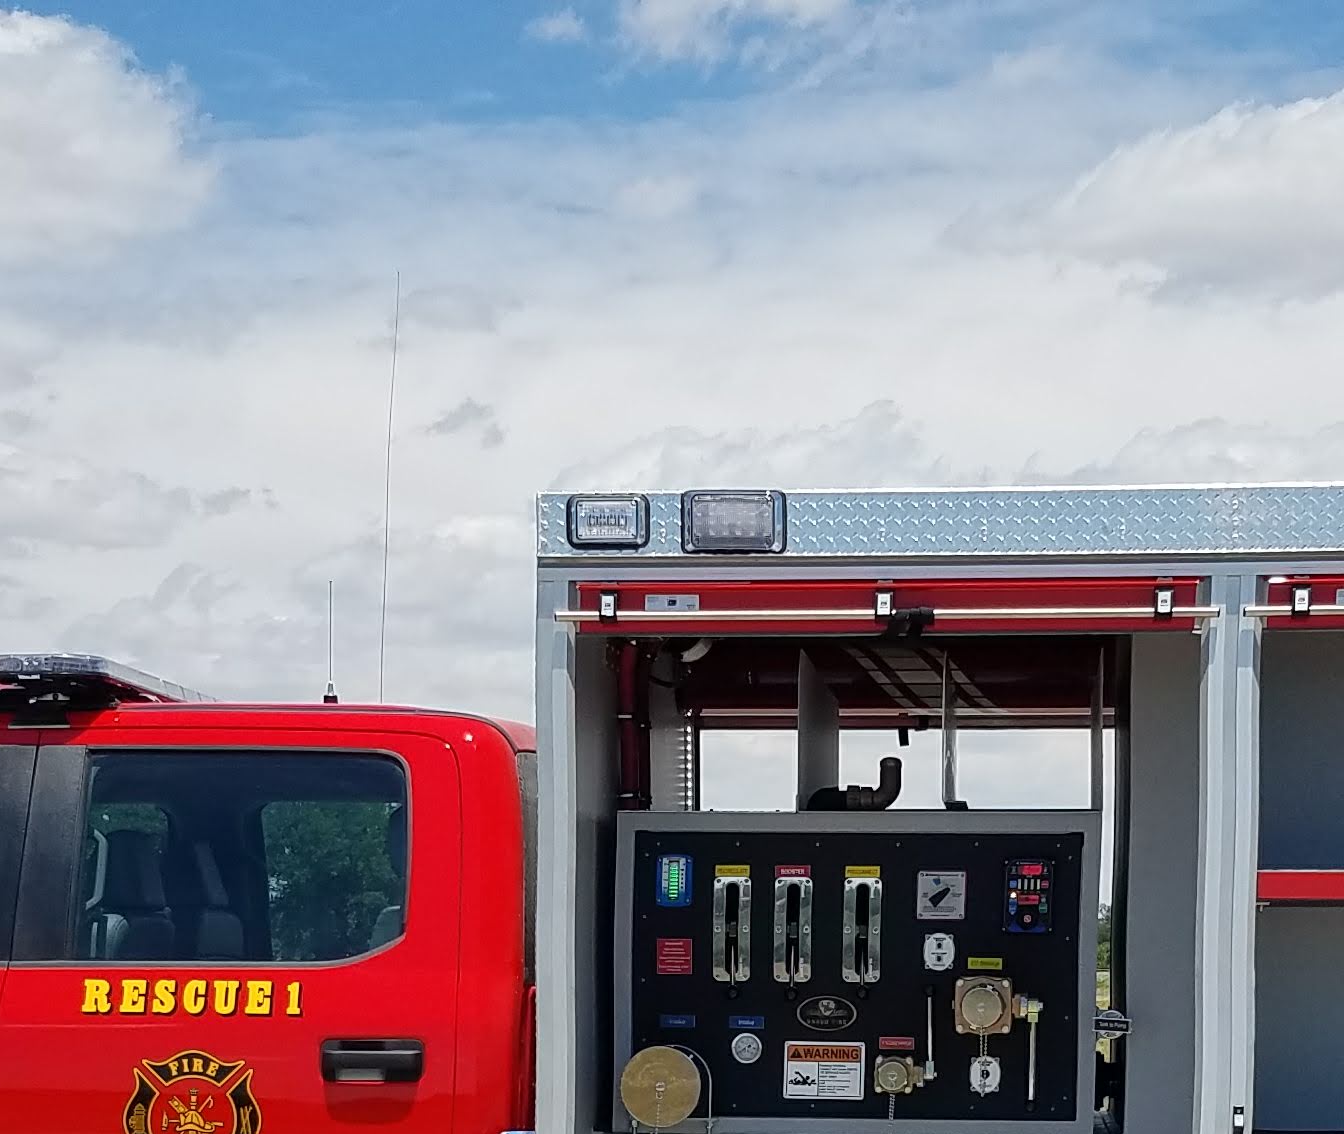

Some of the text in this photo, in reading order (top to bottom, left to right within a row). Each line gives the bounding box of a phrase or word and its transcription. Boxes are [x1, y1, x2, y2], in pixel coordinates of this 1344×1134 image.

[81, 978, 304, 1016] RESCUE 1
[803, 1048, 860, 1060] WARNING
[168, 1057, 220, 1077] FIRE
